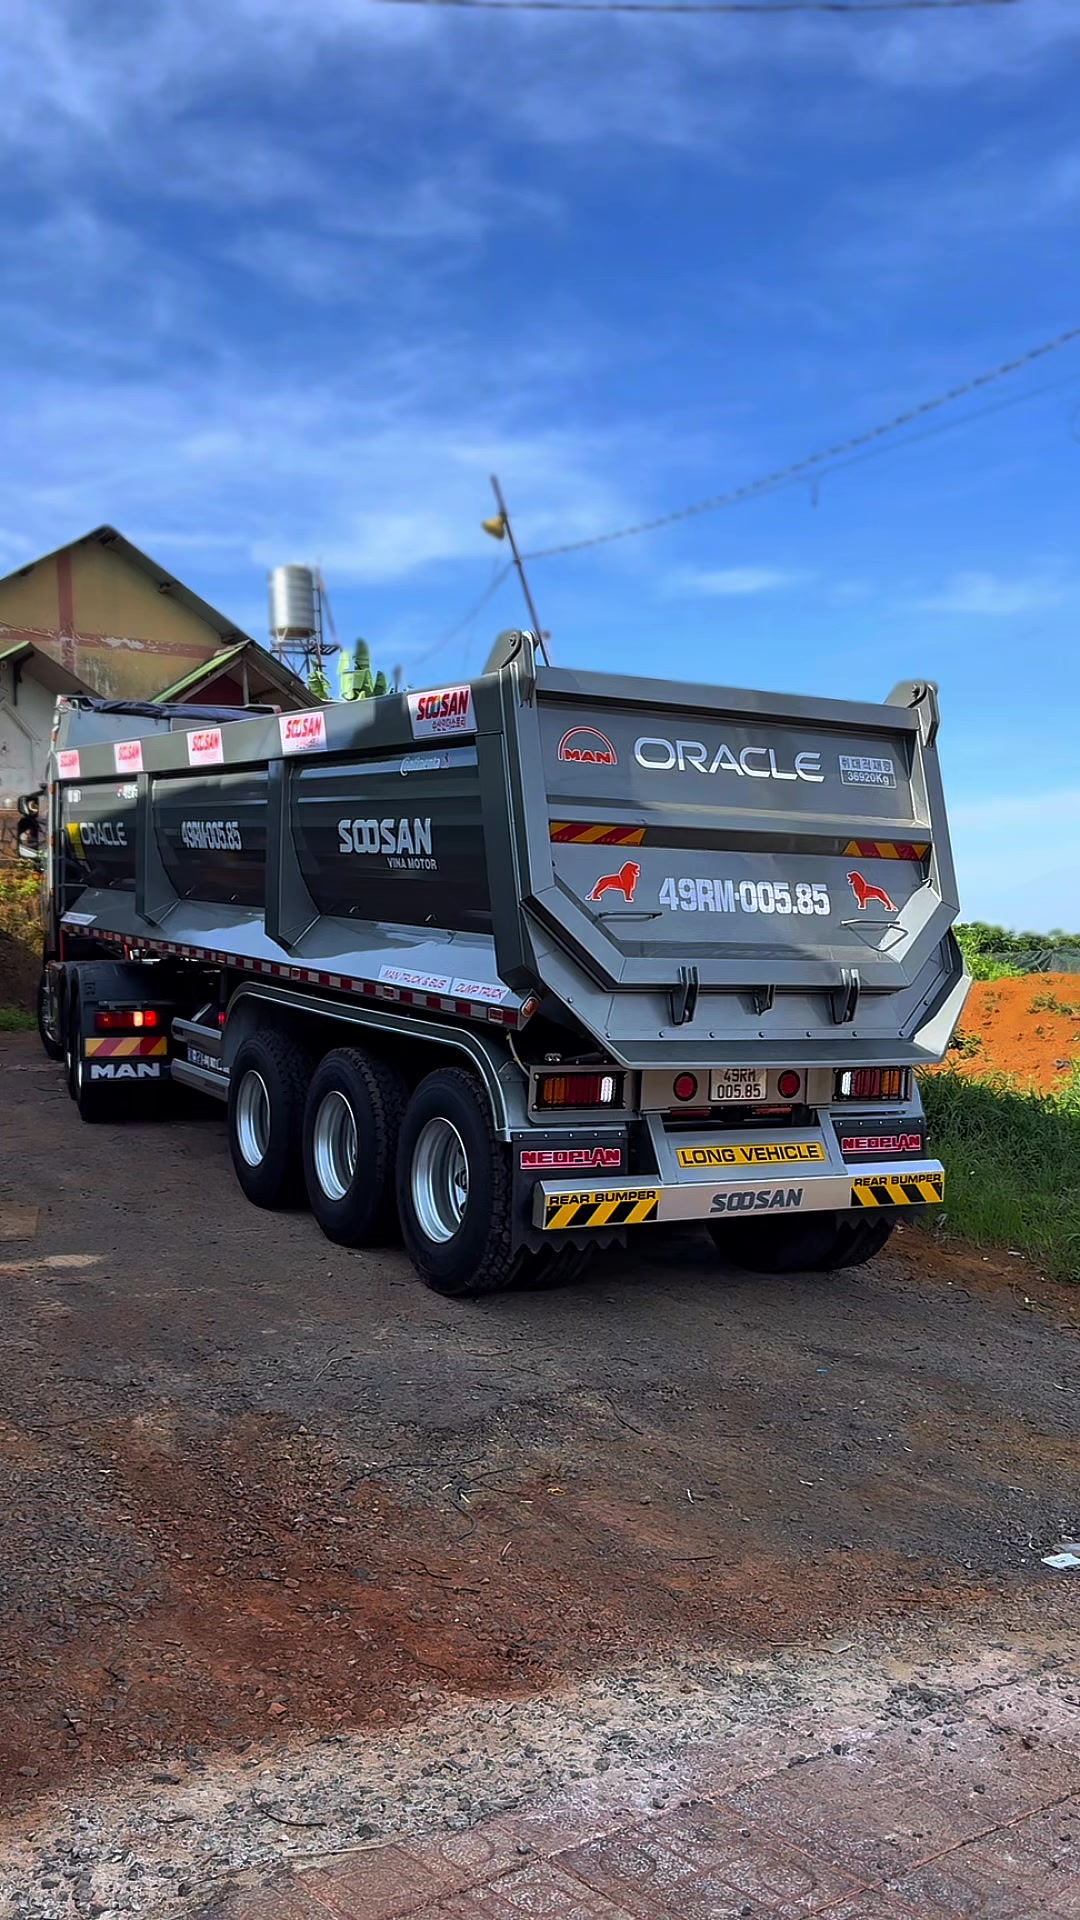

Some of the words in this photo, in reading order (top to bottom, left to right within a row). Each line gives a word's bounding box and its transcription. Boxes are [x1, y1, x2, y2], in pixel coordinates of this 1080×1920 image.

[416, 690, 469, 721] SOOSAN
[285, 717, 322, 739] SOOSAN
[563, 748, 612, 765] MAN
[634, 737, 825, 783] ORACLE
[847, 771, 890, 786] 36920Kg
[79, 822, 128, 846] ORACLE
[338, 818, 433, 855] SOOSAN
[387, 857, 406, 869] VINA
[407, 858, 438, 871] MOTOR
[659, 877, 831, 916] 49RM-005.85
[455, 983, 480, 994] DUMP
[91, 1062, 160, 1079] MAN
[724, 1068, 756, 1082] 49RM
[717, 1084, 761, 1099] 005.85
[841, 1133, 921, 1153] NEOPLAN
[521, 1148, 620, 1168] NEOPLAN
[682, 1148, 735, 1165] LONG
[744, 1144, 821, 1162] VEHICLE
[854, 1176, 889, 1187] REAR
[891, 1173, 942, 1185] BUMPER
[550, 1193, 590, 1205] REAR
[594, 1190, 657, 1203] BUMPER
[710, 1188, 803, 1213] SOOSAN
